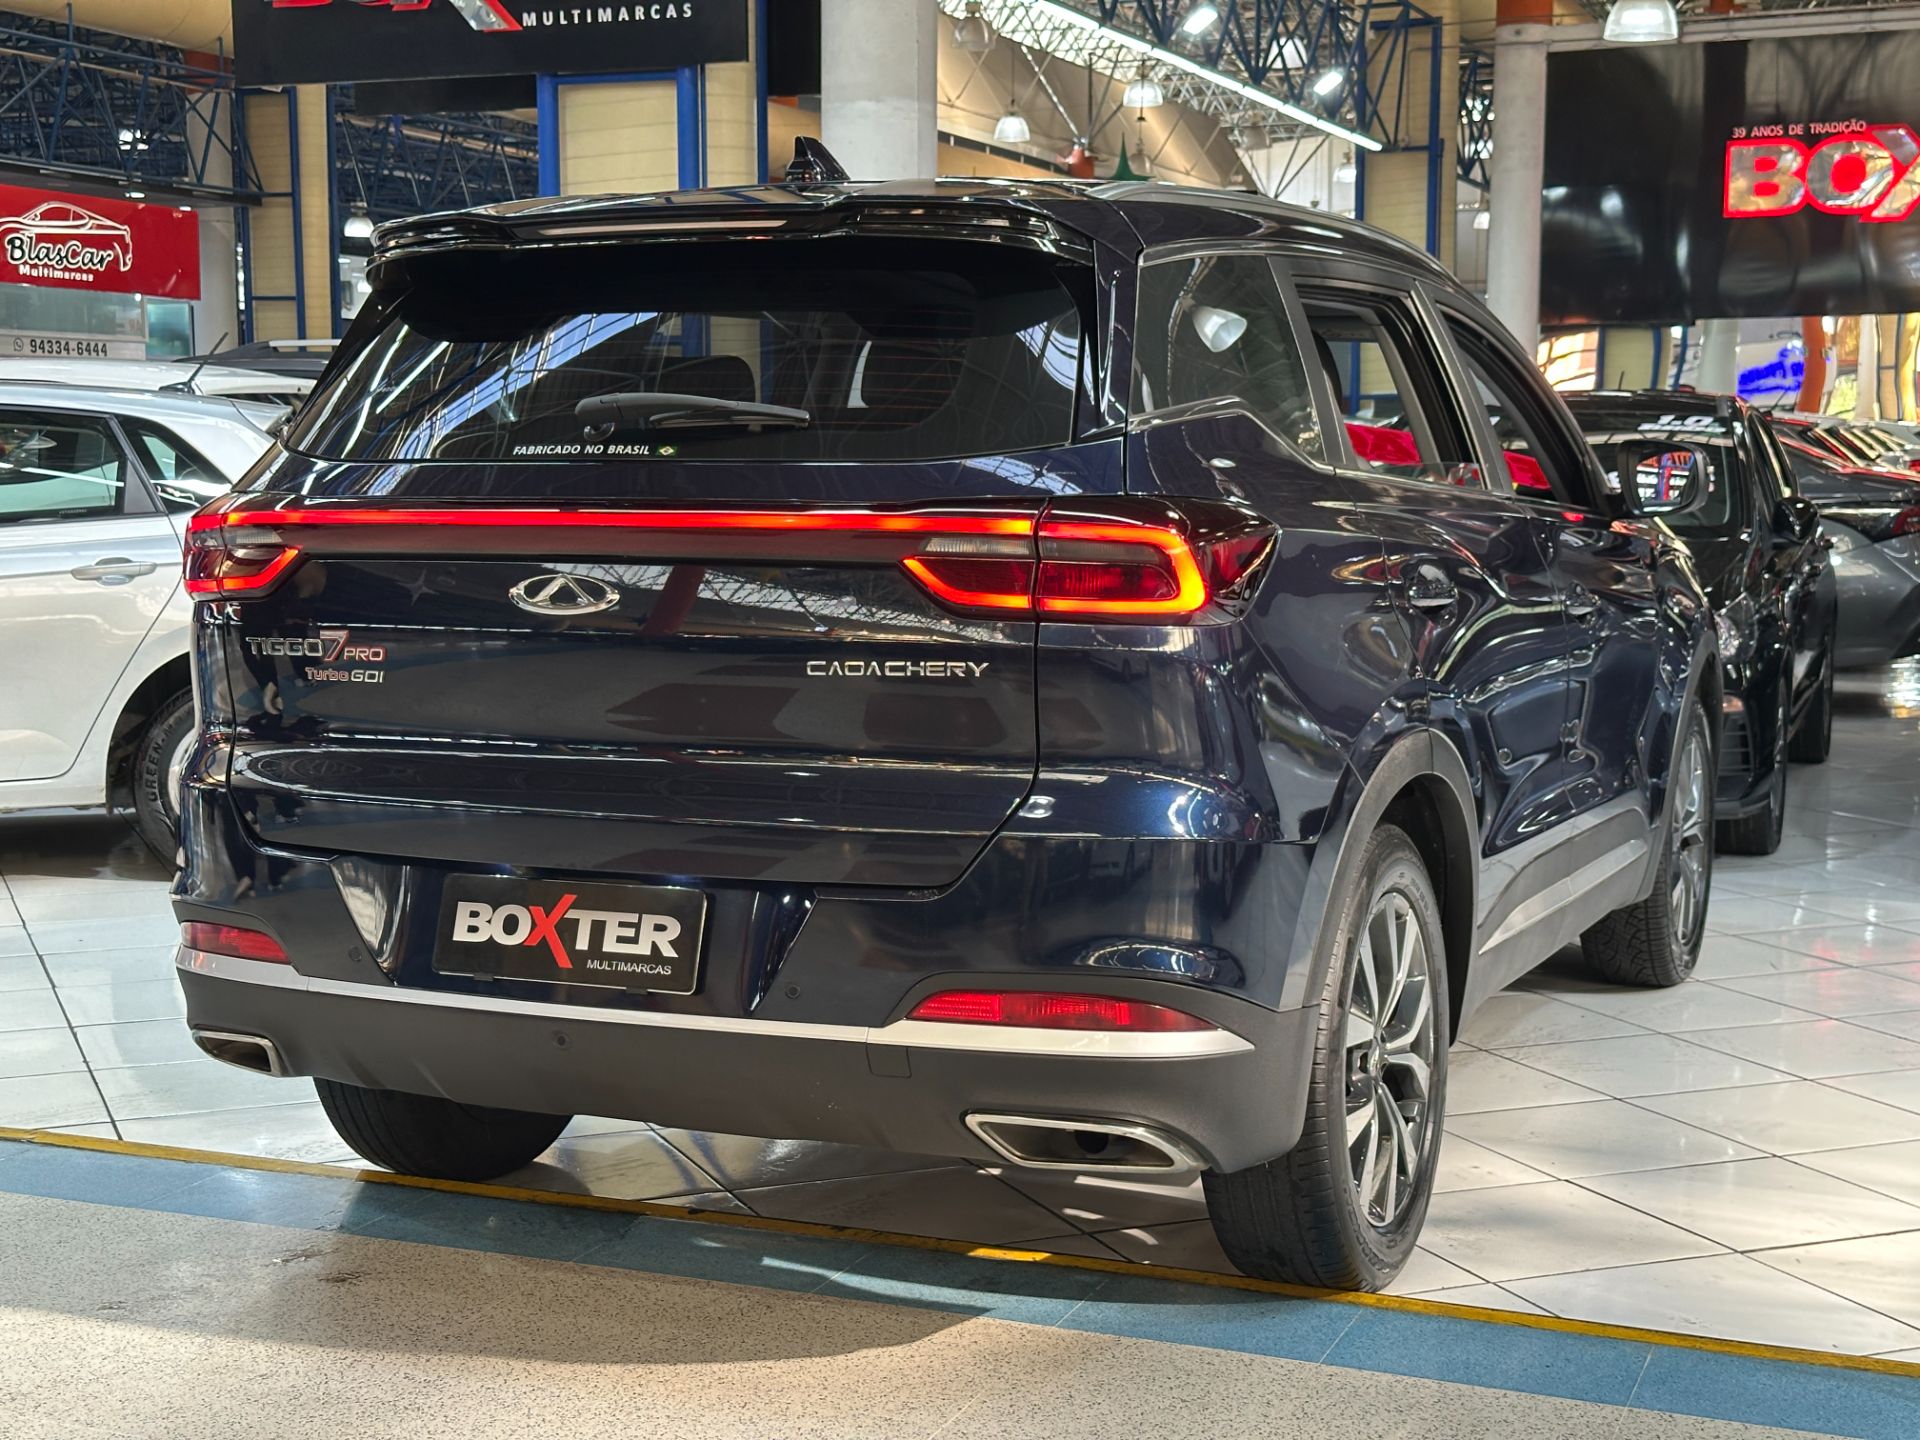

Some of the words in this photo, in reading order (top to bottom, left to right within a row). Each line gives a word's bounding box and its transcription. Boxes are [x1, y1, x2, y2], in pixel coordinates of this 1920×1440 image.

[522, 3, 693, 27] MULTIMARCAS
[1732, 127, 1746, 138] 39
[1751, 125, 1784, 137] ANOS
[1788, 124, 1804, 136] DE
[1809, 118, 1867, 135] TRADIÇÃO
[5, 231, 114, 272] BlasCar
[18, 264, 94, 282] Multimarcas
[30, 338, 108, 358] 94334-6444
[512, 445, 581, 456] FABRICADO
[584, 444, 604, 455] NO
[607, 444, 650, 455] BRASIL
[452, 894, 682, 969] BOXTER
[587, 959, 672, 975] MULTIMARCAS
